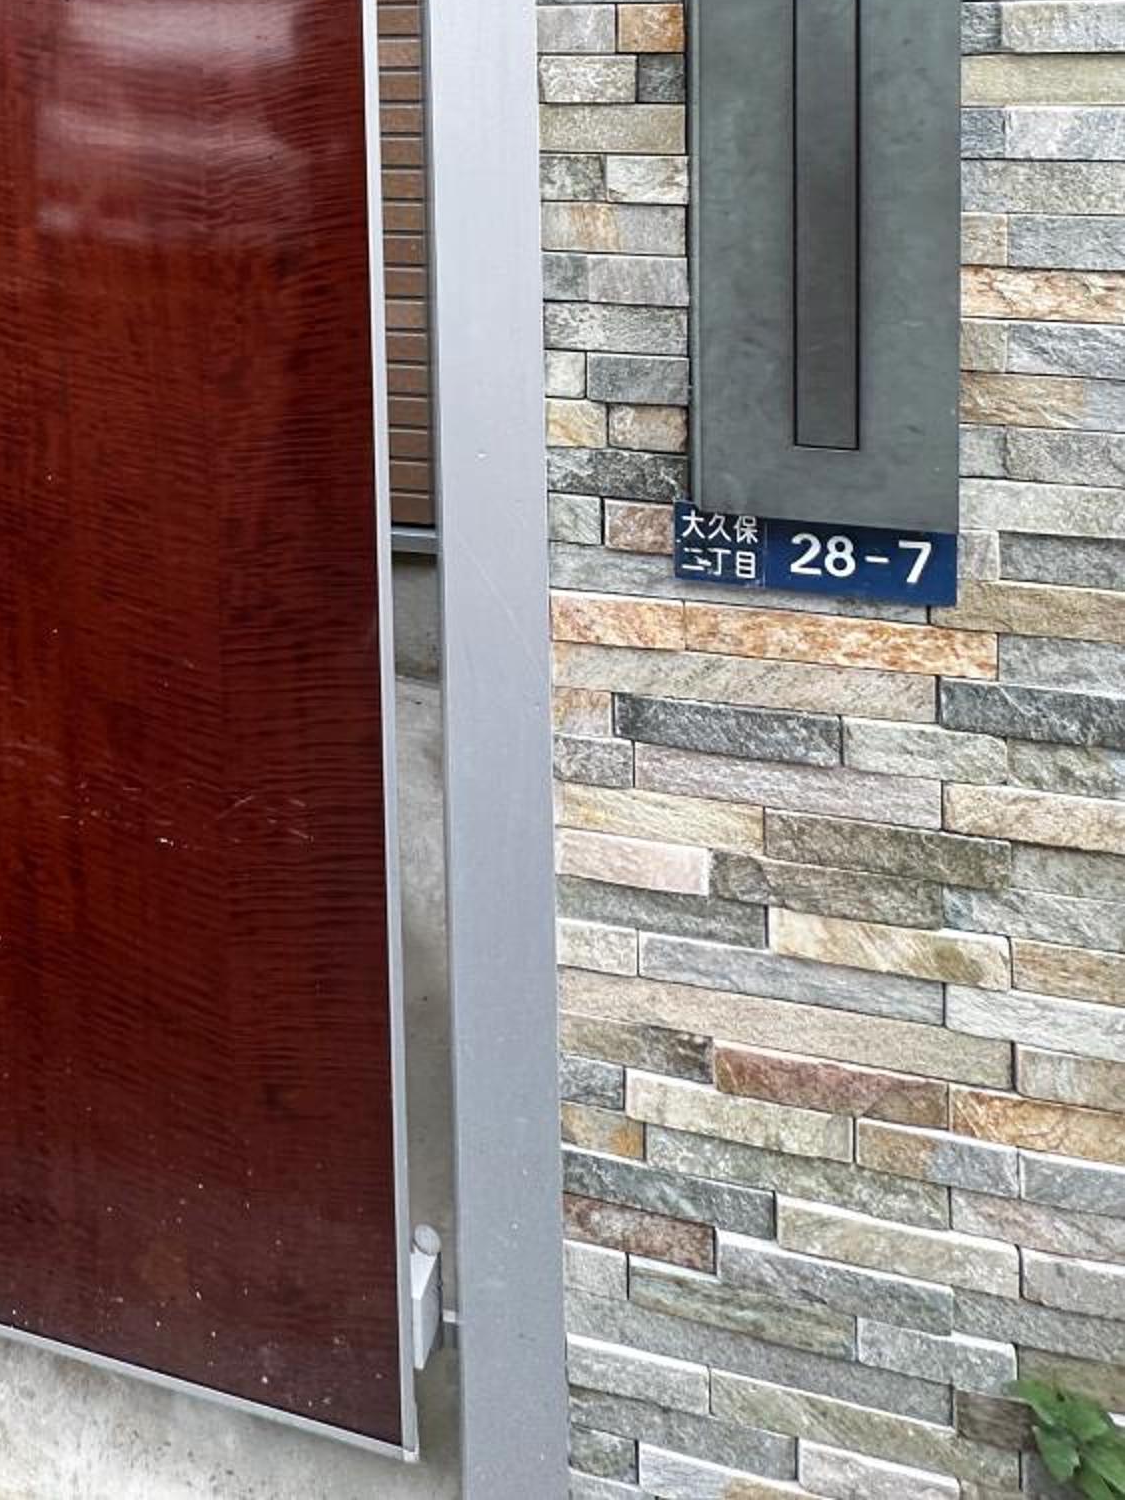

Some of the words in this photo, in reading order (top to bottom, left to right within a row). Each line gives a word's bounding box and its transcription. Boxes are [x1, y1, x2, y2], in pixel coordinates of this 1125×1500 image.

[681, 510, 759, 545] 大久保
[681, 547, 757, 580] 二丁目
[789, 532, 933, 584] 28-7
